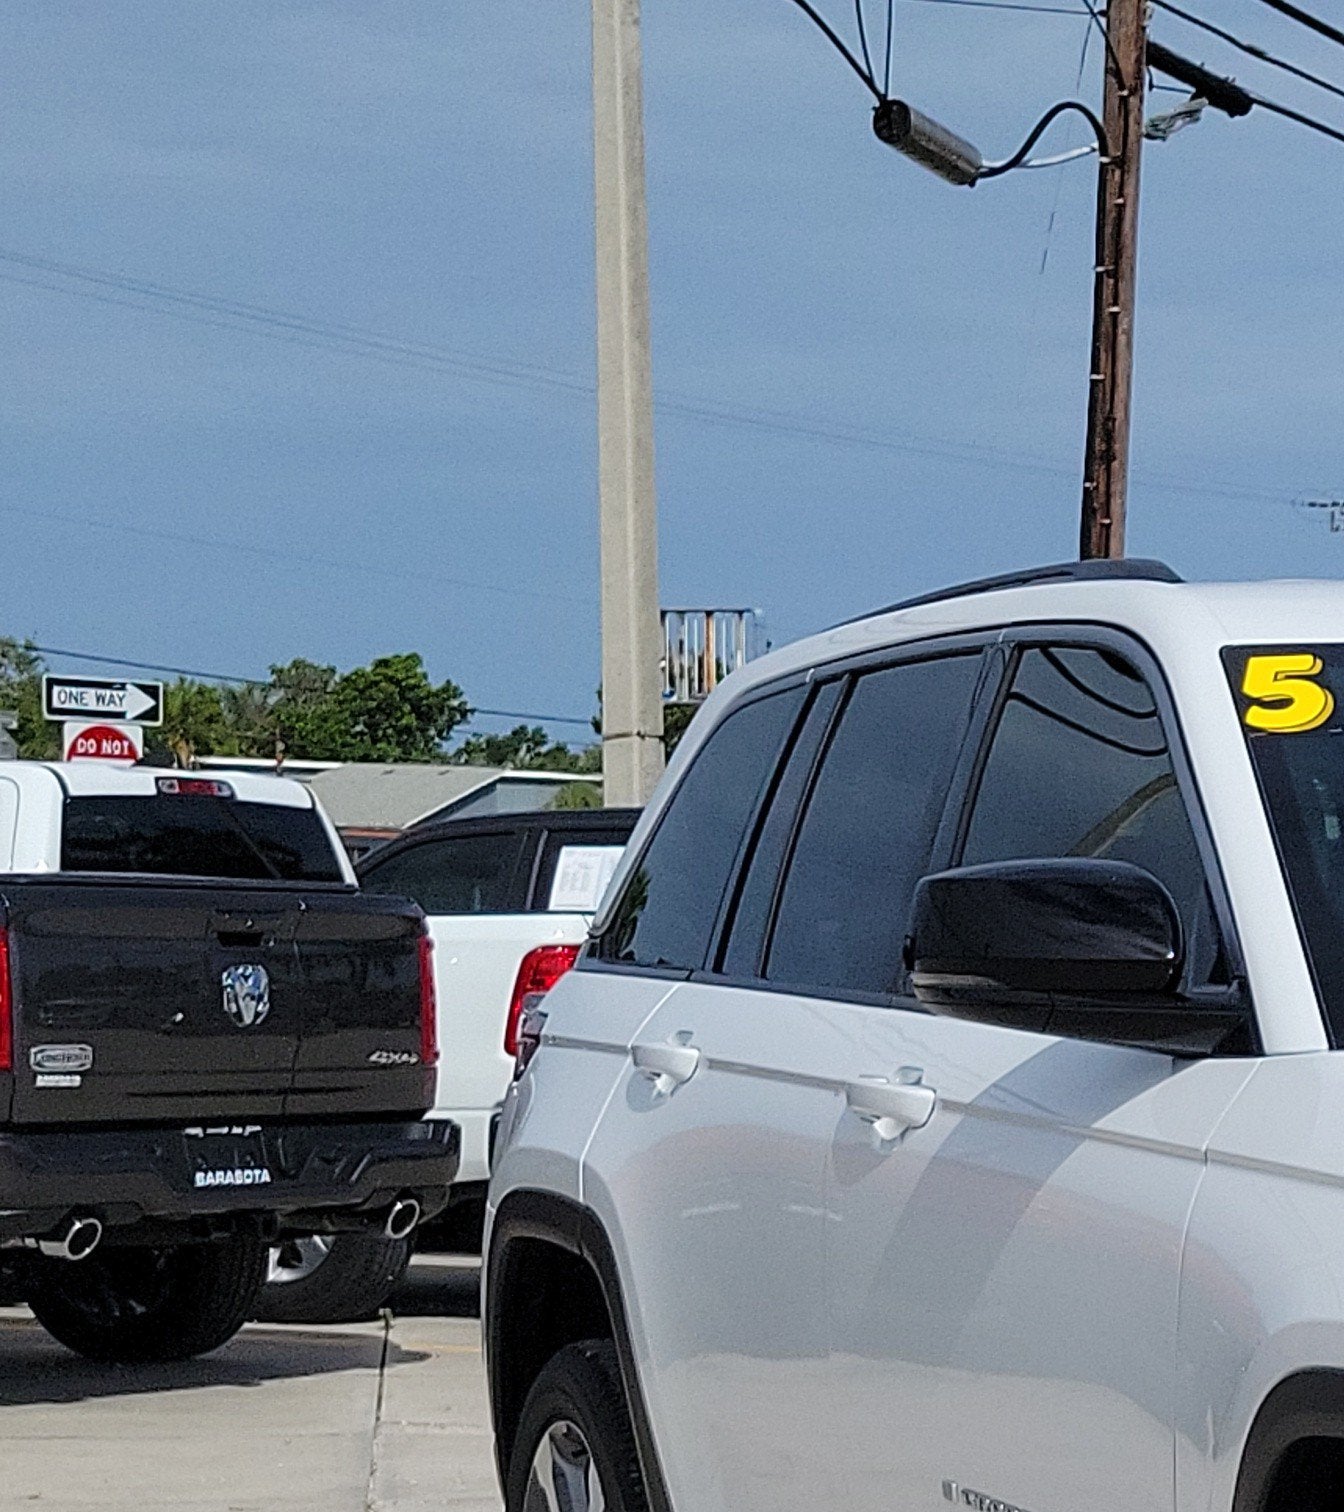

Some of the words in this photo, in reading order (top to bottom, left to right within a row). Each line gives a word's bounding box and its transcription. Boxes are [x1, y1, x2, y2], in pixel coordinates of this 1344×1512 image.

[57, 688, 88, 706] ONE
[94, 691, 127, 708] WAY
[1242, 653, 1335, 733] 5
[76, 737, 97, 754] DO
[101, 738, 130, 756] NOT
[193, 1168, 272, 1188] SARASOTA
